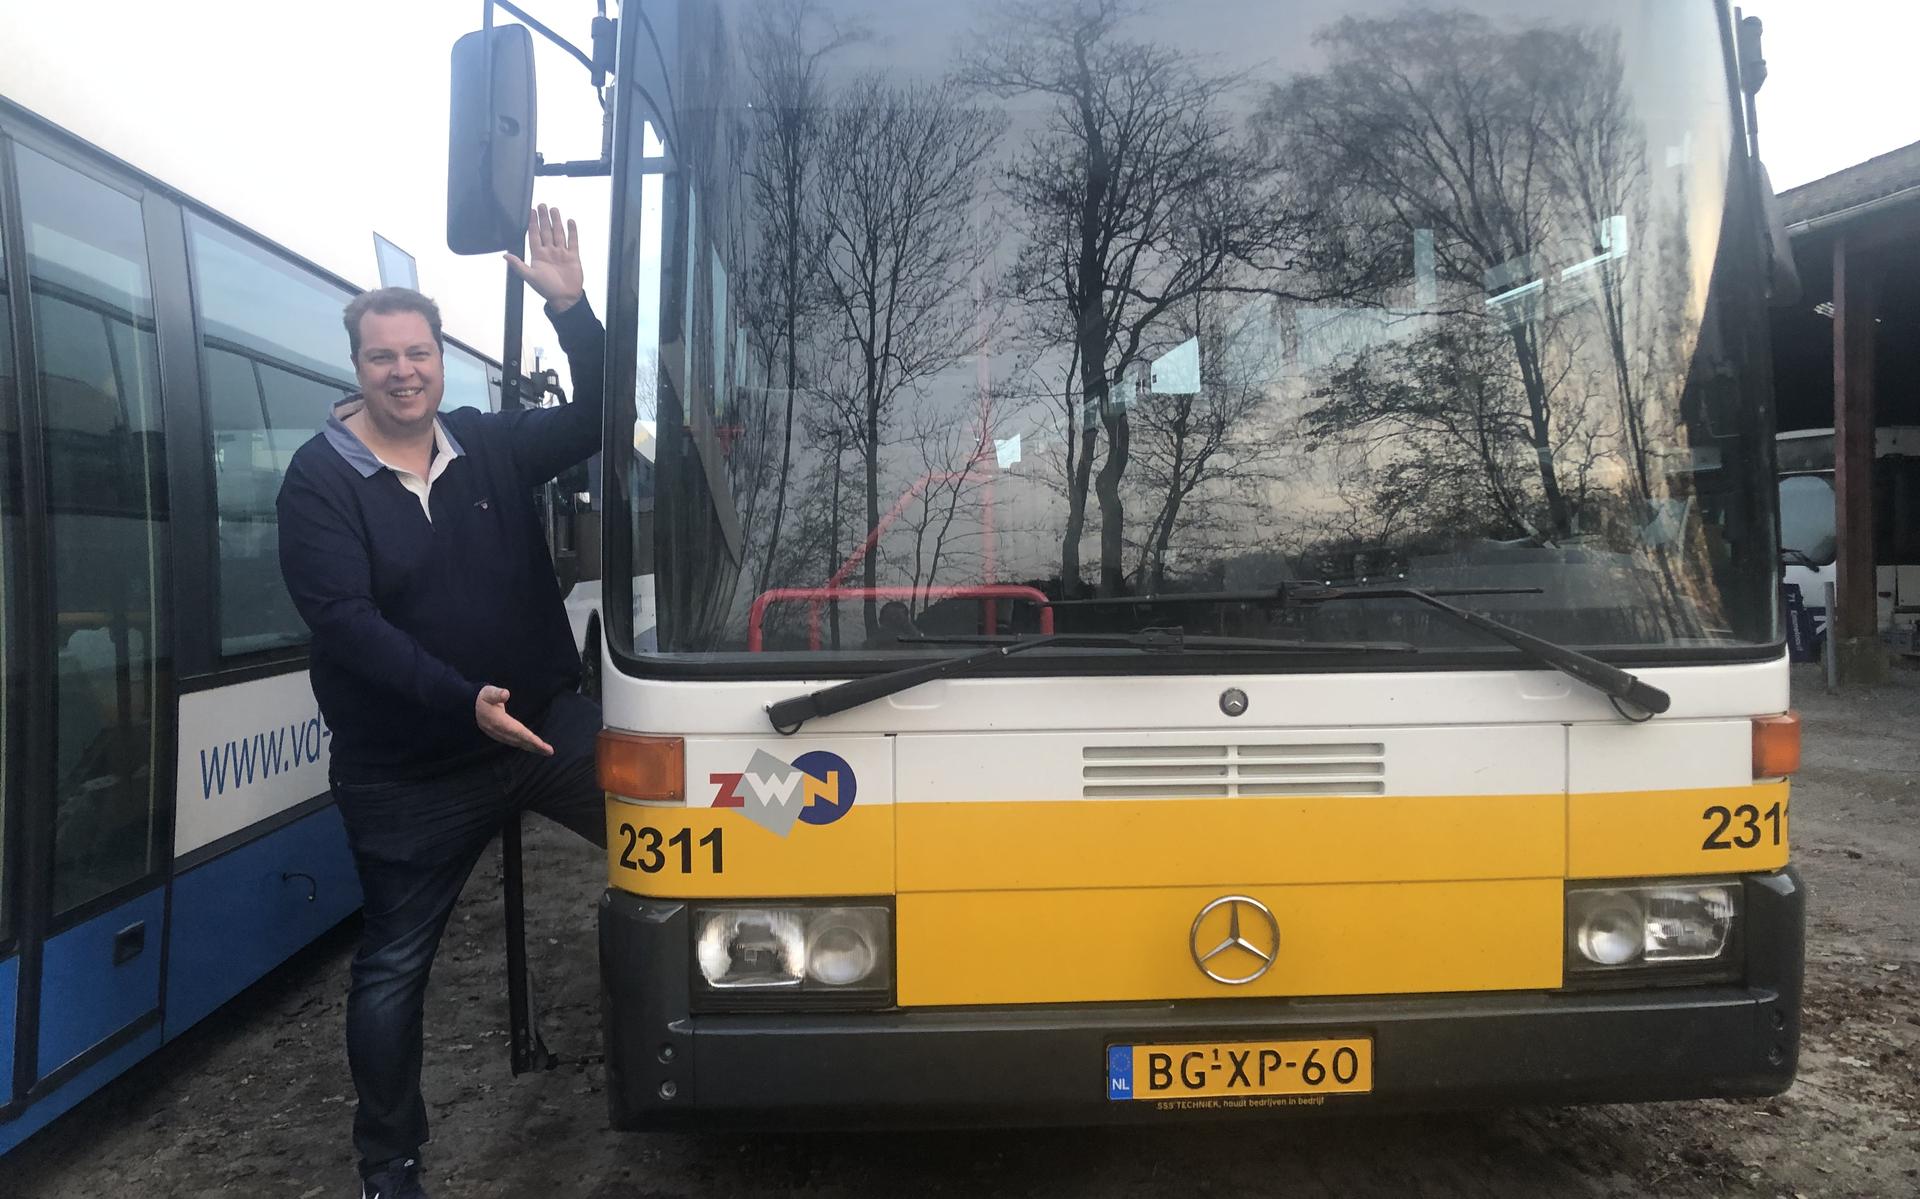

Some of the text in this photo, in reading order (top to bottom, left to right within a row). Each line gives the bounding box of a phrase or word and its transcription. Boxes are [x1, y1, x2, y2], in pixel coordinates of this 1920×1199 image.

[200, 710, 331, 800] www.vd-
[709, 770, 838, 808] ZWN
[619, 822, 723, 873] 2311
[1702, 801, 1789, 850] 231
[1112, 1078, 1130, 1091] NL
